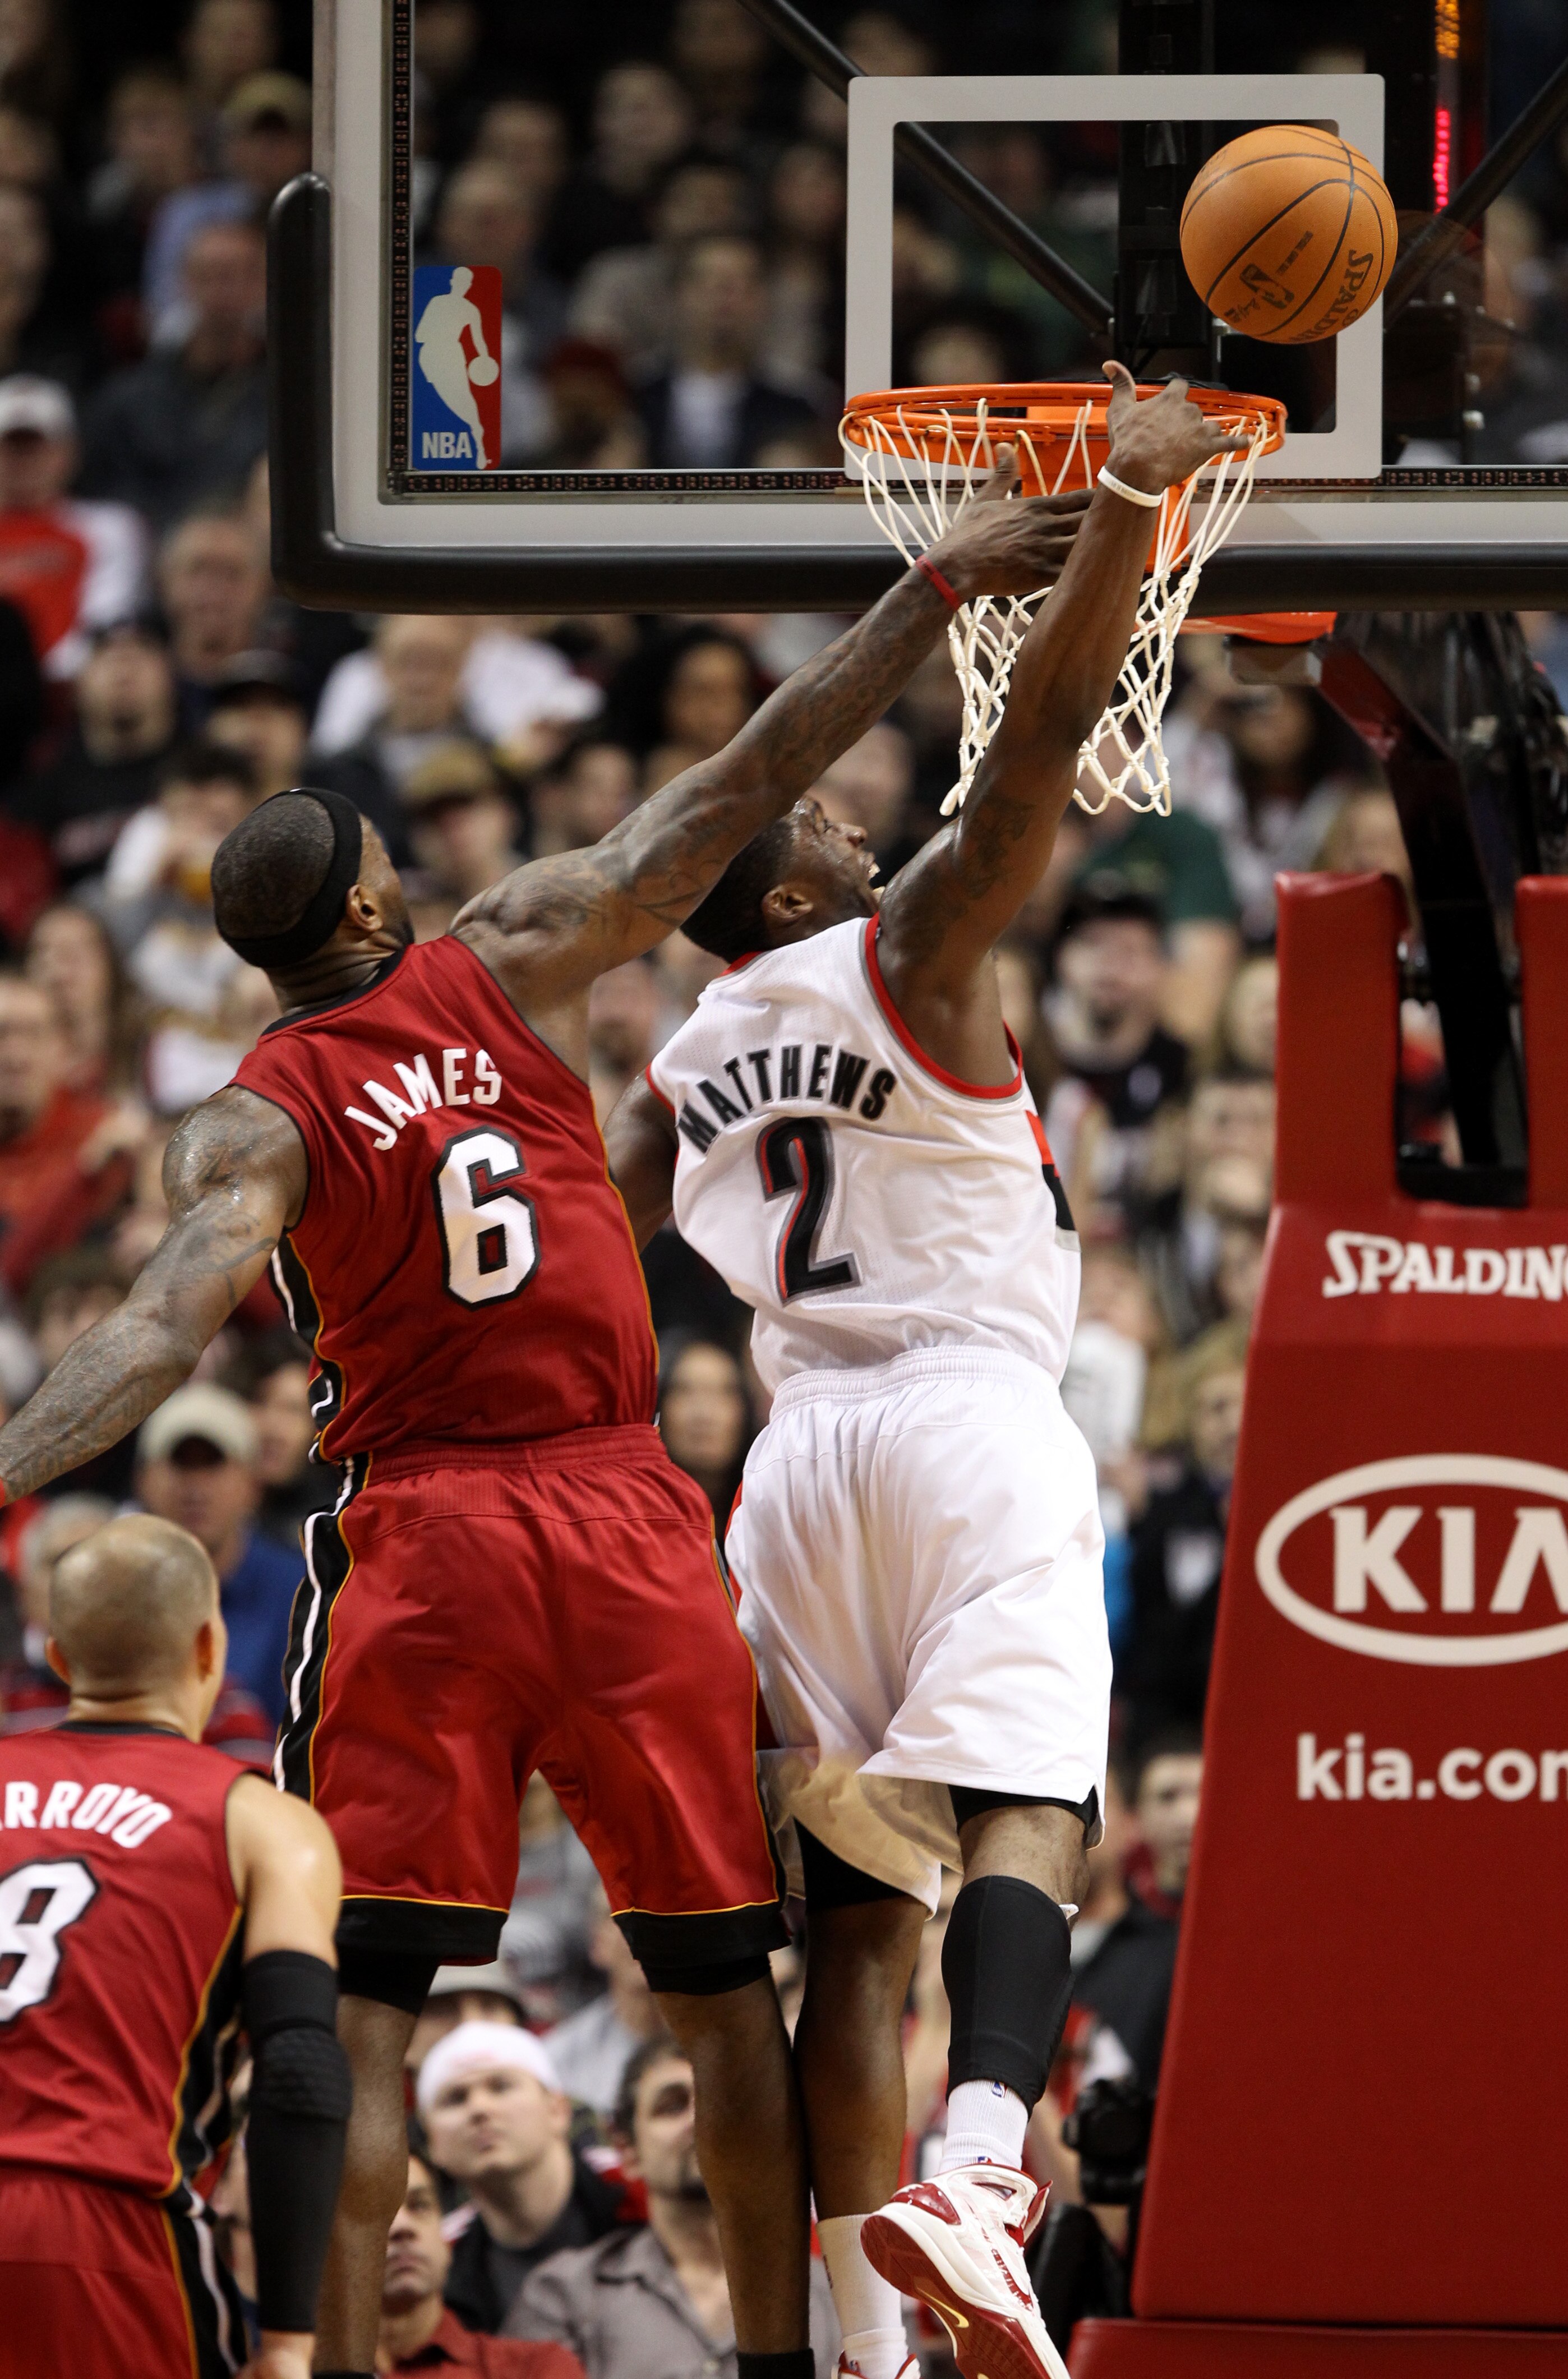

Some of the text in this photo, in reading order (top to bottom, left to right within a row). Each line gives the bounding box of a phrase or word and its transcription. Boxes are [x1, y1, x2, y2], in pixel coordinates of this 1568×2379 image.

[422, 432, 473, 458] NBA
[344, 1048, 502, 1151] JAMES
[677, 1044, 897, 1155] MATTHEWS
[431, 1125, 542, 1311] 6
[755, 1116, 863, 1308] 2
[1322, 1229, 1568, 1301] SPALDIN
[1328, 1505, 1568, 1615] KIA
[0, 1781, 172, 1848] RROYO
[0, 1855, 100, 2027] 8
